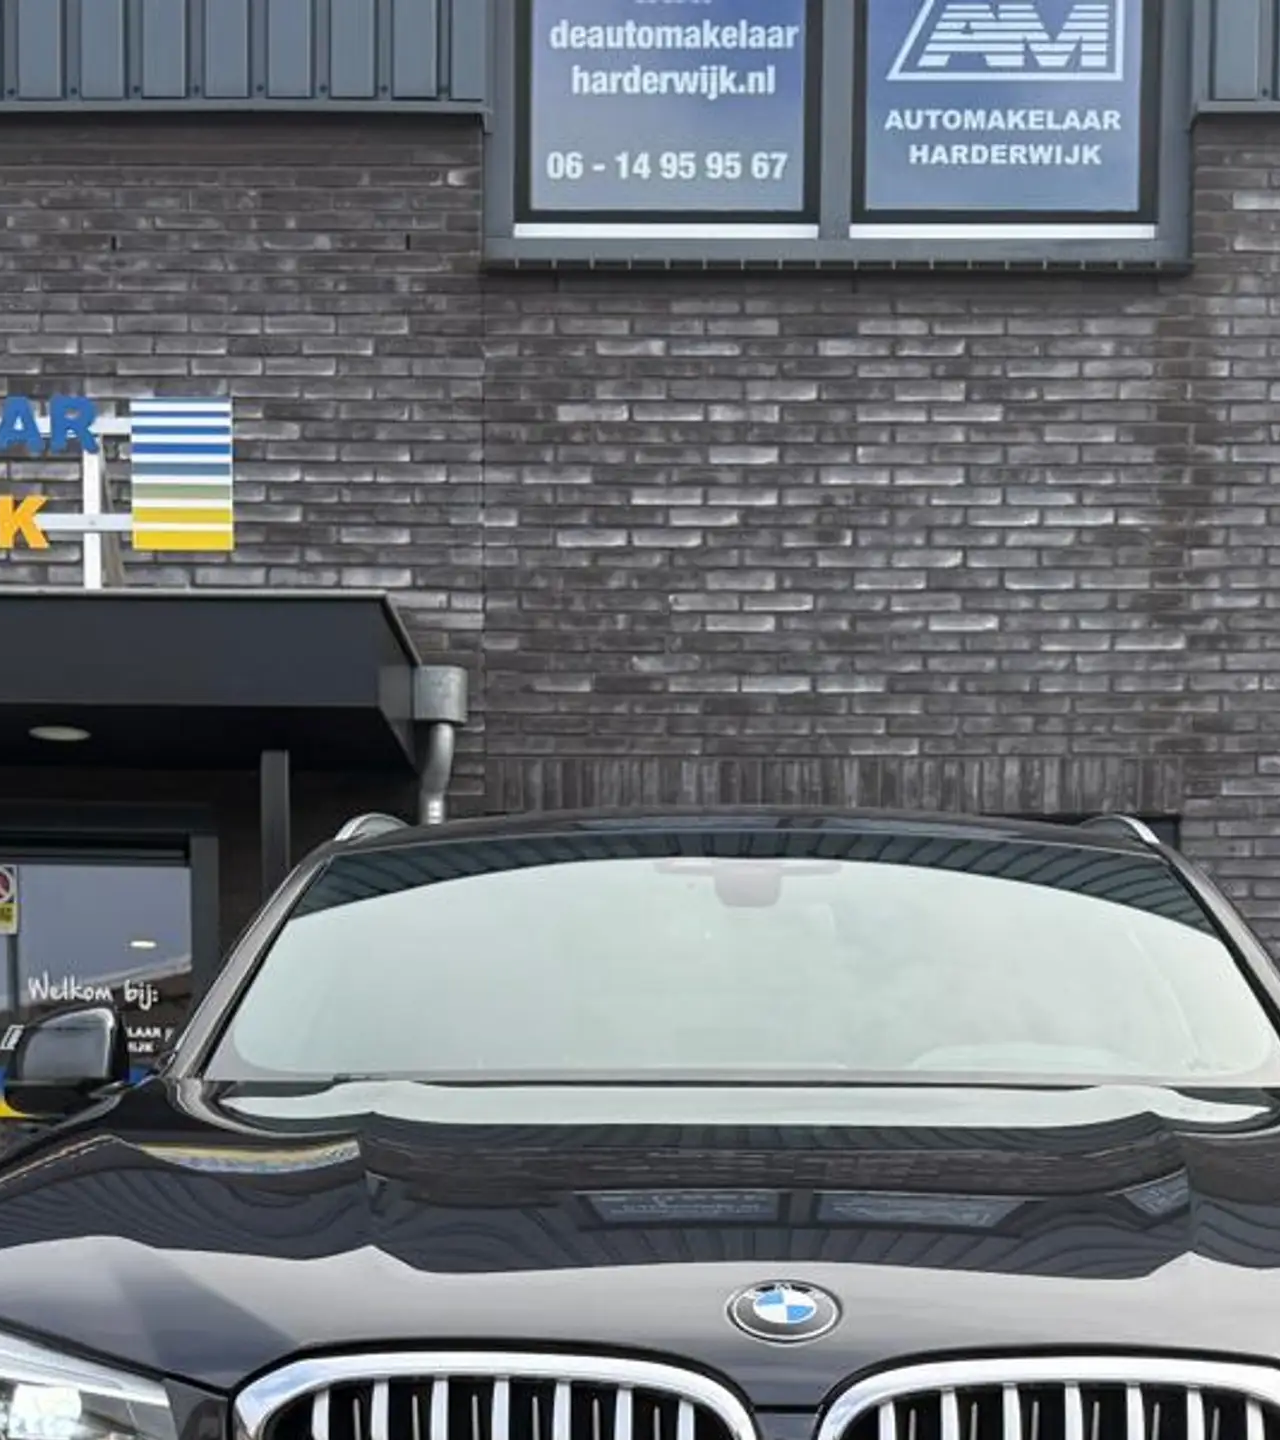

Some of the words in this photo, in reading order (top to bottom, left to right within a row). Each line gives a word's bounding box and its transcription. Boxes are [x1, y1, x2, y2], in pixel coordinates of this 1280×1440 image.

[549, 19, 799, 49] deautomakelaar
[571, 64, 776, 100] harderwijk.nl
[884, 109, 1122, 130] AUTOMAKELAAR
[546, 150, 581, 180] 06
[615, 150, 652, 180] 14
[659, 150, 698, 180] 95
[704, 150, 743, 180] 95
[750, 150, 788, 180] 67
[908, 145, 1104, 165] HARDERWIJK
[27, 970, 115, 1002] Welkom
[124, 979, 159, 1011] bij:
